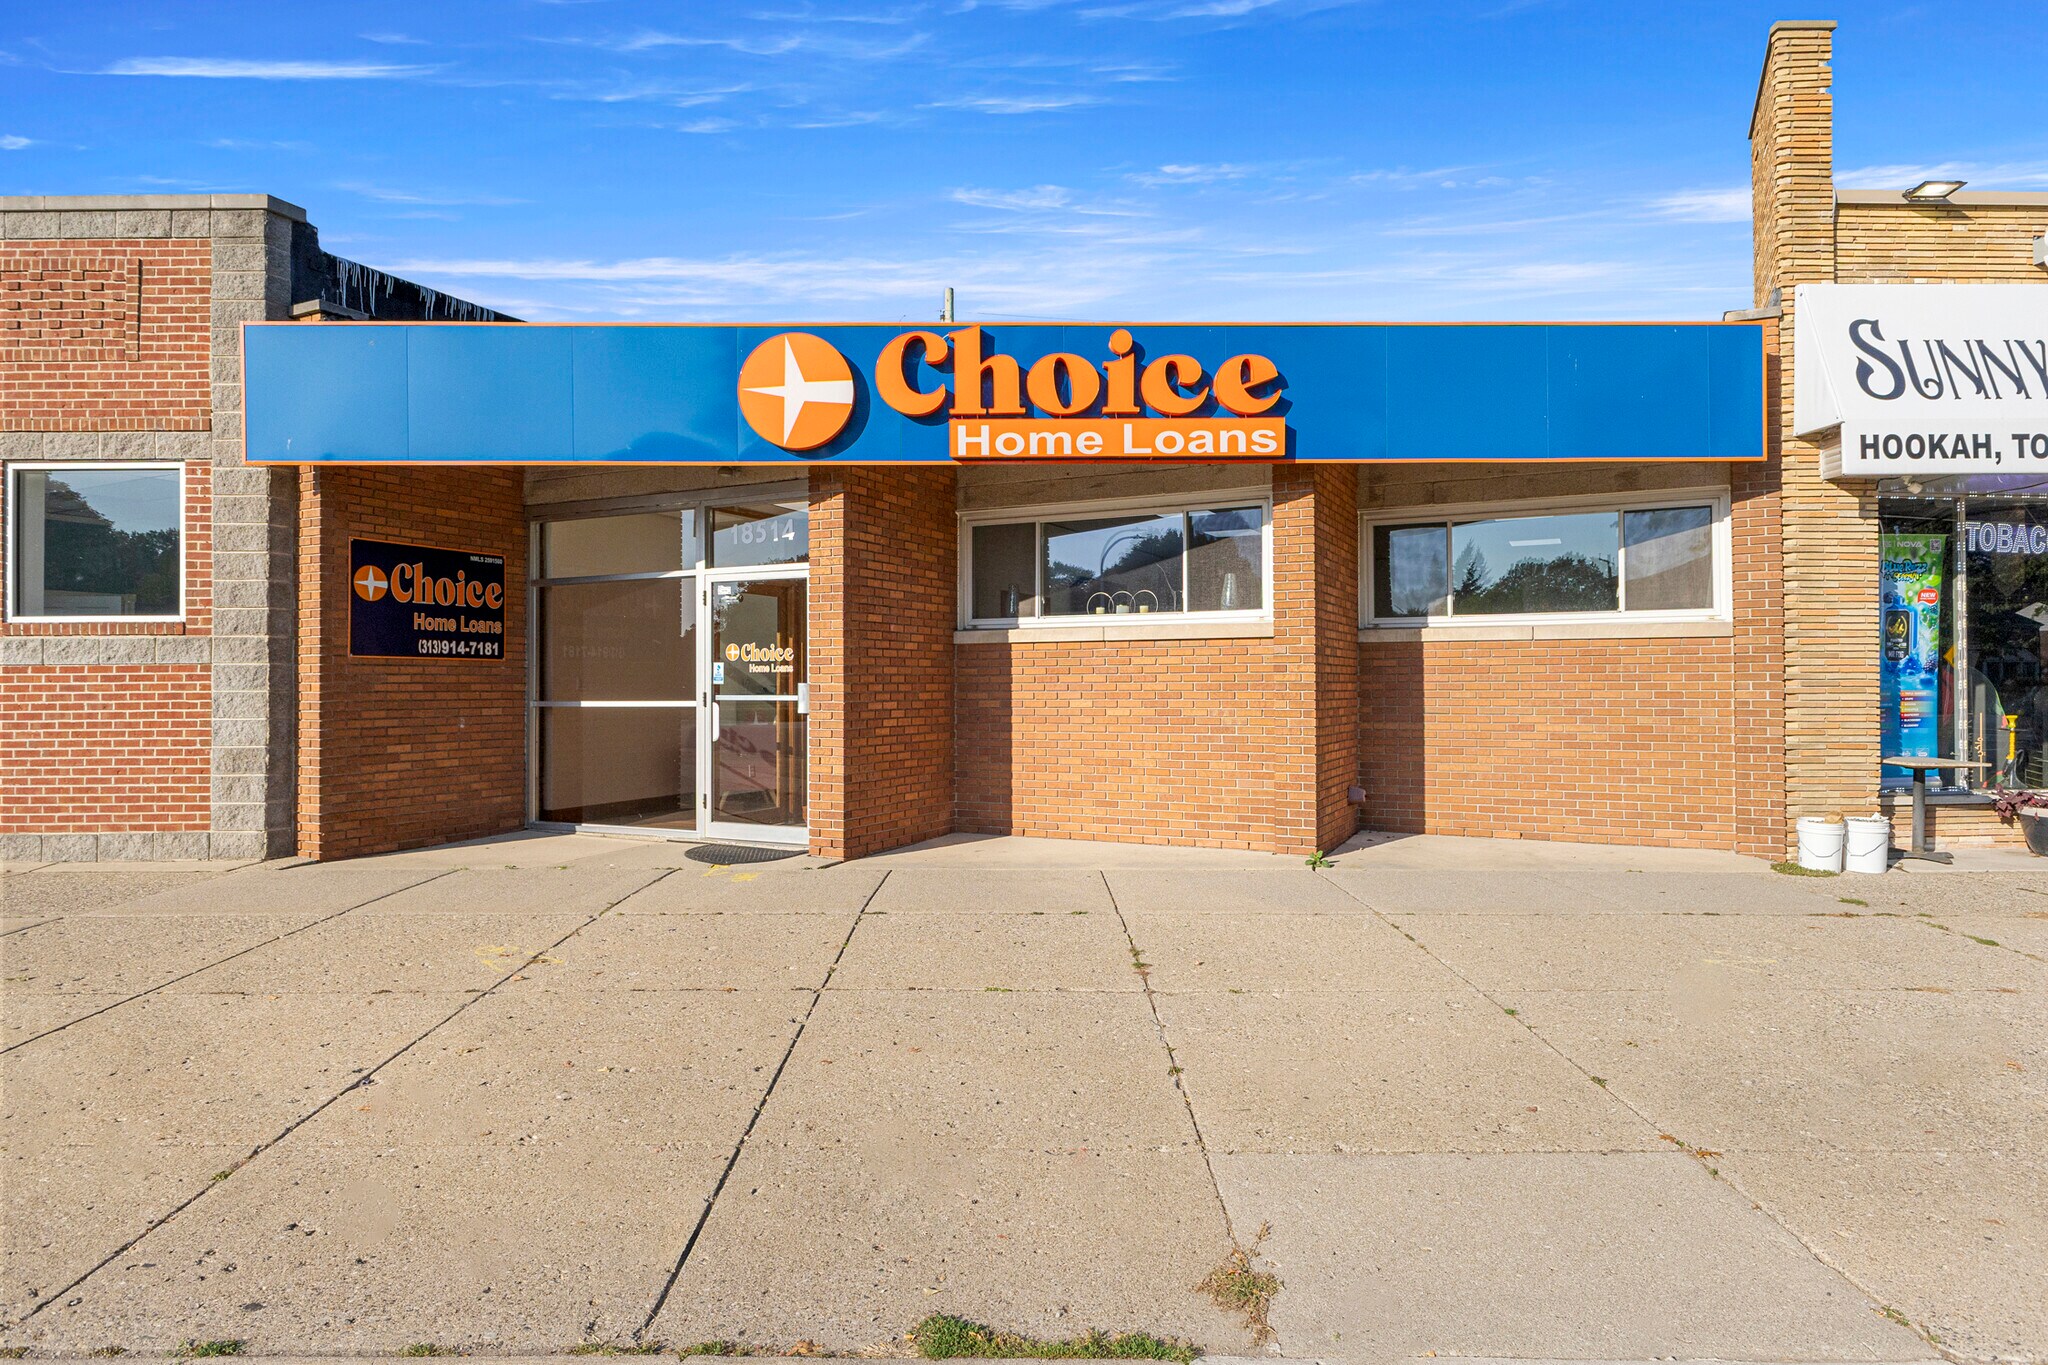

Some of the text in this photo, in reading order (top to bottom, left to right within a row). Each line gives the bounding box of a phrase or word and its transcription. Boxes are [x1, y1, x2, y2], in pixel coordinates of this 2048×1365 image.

[875, 325, 1283, 416] Choice
[957, 423, 1278, 456] Home Loans
[1860, 433, 2001, 465] HOOKAH,
[730, 518, 795, 545] 18514
[1965, 521, 2048, 554] TOBAC
[390, 562, 504, 610] Choice
[413, 612, 503, 634] Home Loans
[418, 639, 499, 656] (313)914-7181
[741, 642, 794, 662] Choice
[749, 663, 794, 673] Home Loans
